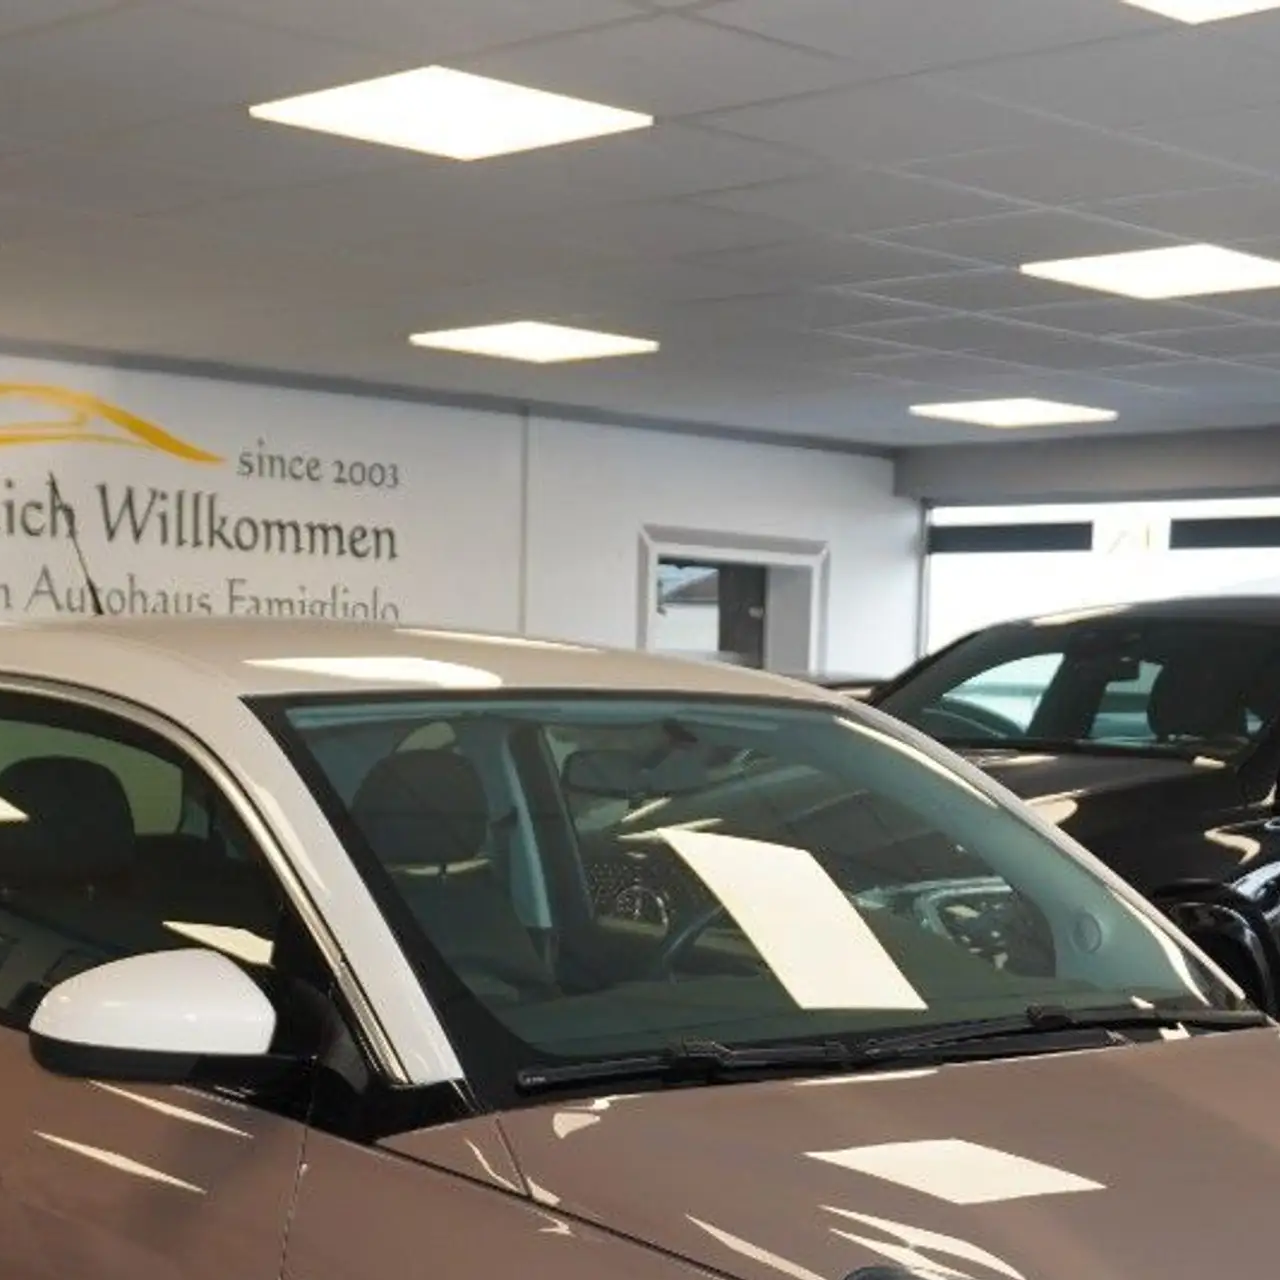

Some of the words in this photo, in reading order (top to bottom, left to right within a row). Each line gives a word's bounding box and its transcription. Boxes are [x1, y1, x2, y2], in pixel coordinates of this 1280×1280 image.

[236, 437, 322, 482] since
[331, 459, 400, 489] 2003
[96, 482, 398, 560] Willkommen
